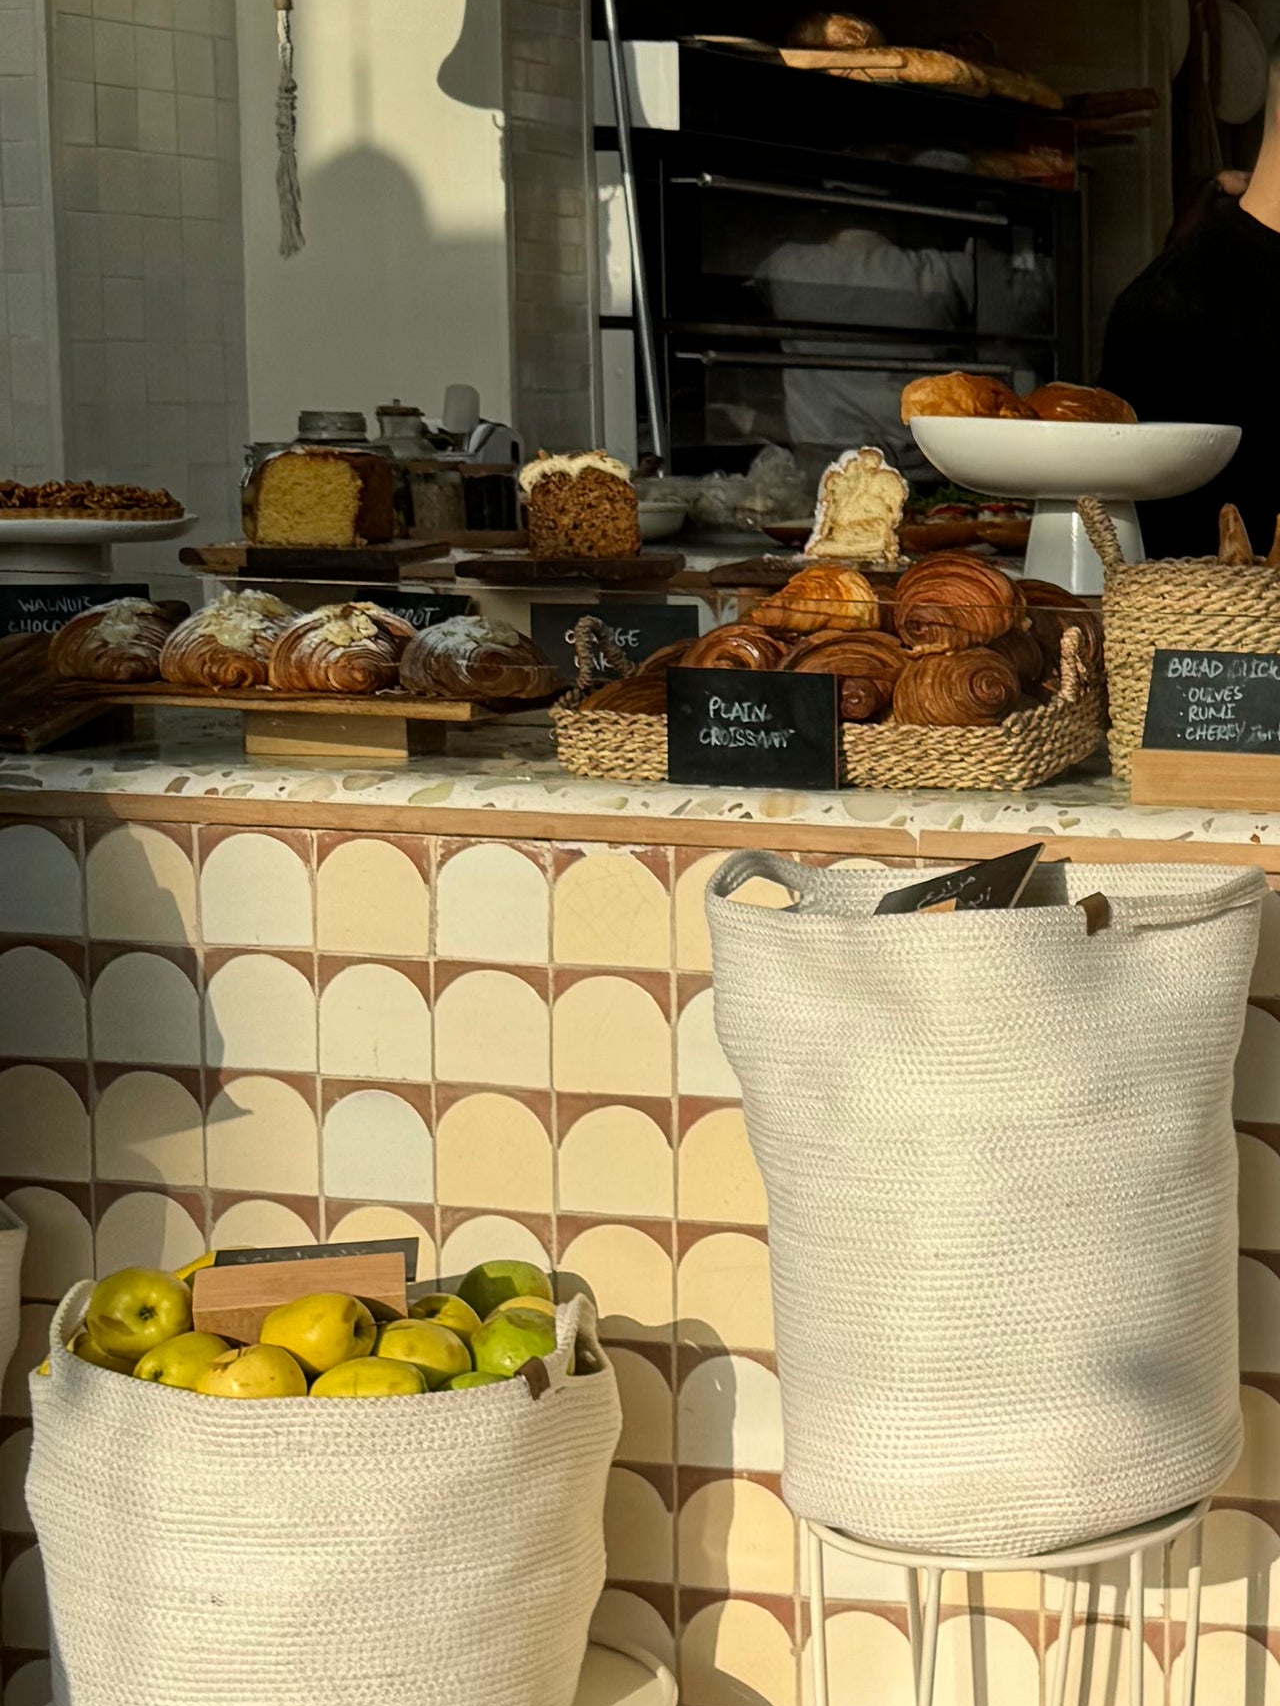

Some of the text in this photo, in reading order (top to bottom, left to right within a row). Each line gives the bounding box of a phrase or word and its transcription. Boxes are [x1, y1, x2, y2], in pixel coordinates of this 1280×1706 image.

[1167, 657, 1223, 679] BREAD
[1188, 685, 1243, 704] OLIVES
[709, 695, 768, 723] PLAIN
[1188, 703, 1237, 723] RUMI
[1185, 720, 1247, 742] CHERRY
